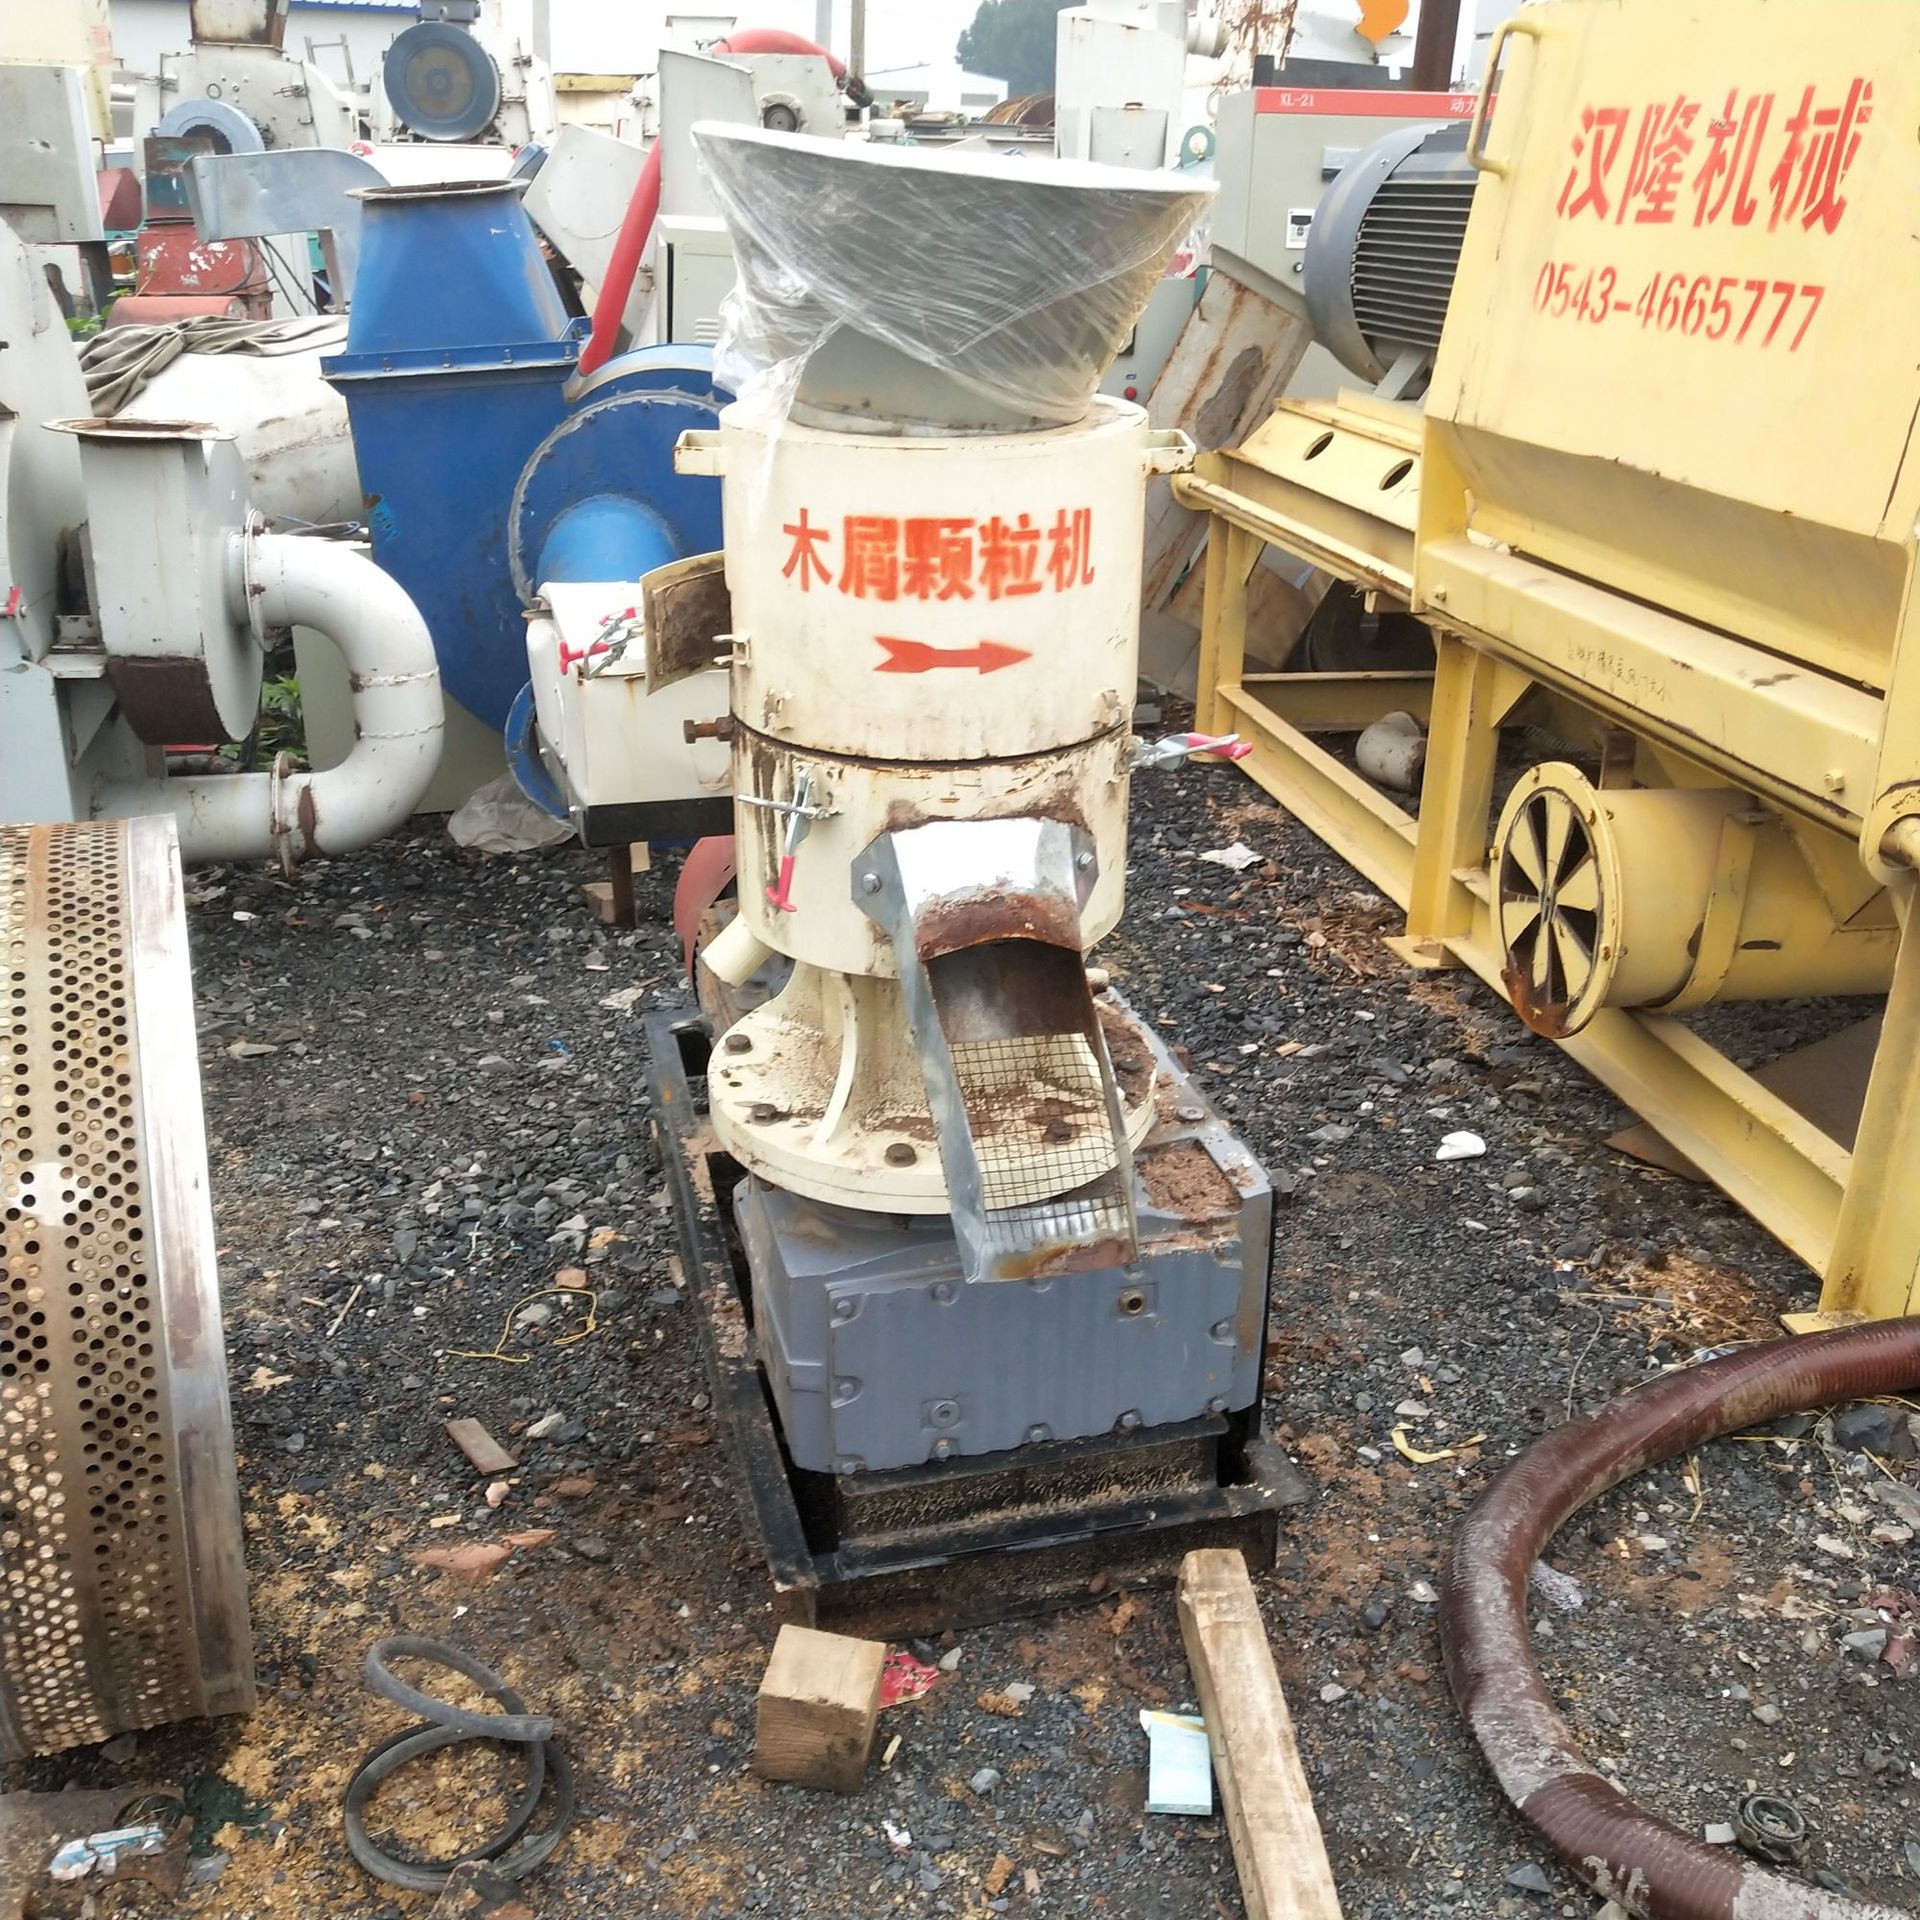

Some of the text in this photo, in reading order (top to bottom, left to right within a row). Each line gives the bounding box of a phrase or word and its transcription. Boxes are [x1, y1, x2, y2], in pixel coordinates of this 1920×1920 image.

[1279, 93, 1491, 115] XL-21 动力
[1556, 78, 1873, 235] 汉隆机械
[1533, 260, 1825, 352] 0543-4665777
[782, 507, 1095, 601] 木屑颗粒机
